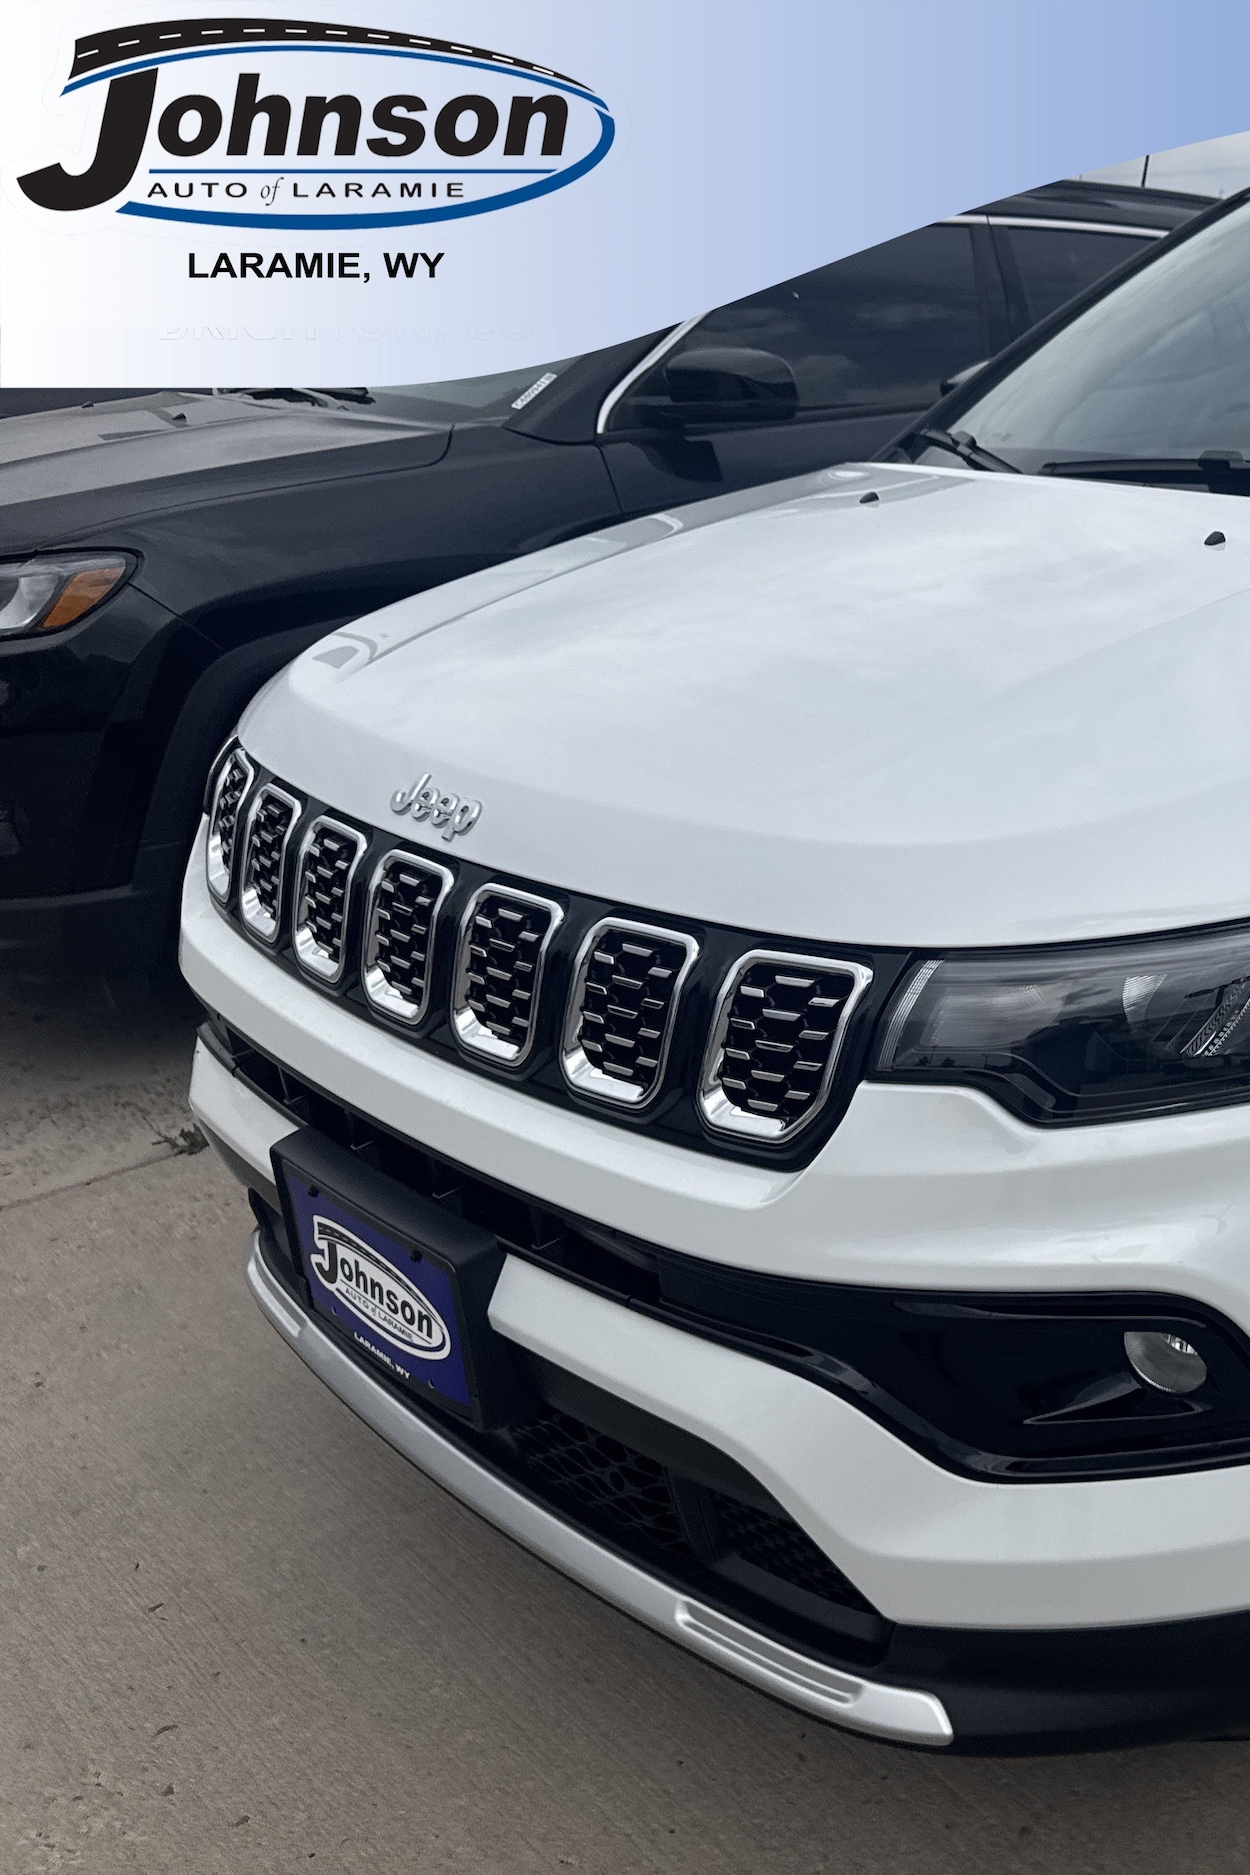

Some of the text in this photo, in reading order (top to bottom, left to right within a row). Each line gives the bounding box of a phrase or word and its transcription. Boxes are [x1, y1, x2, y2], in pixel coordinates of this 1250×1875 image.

[390, 771, 482, 842] Jeep
[315, 1241, 433, 1340] Johnson
[345, 1287, 370, 1311] AUTO
[379, 1312, 414, 1342] LARAMIE
[395, 1363, 411, 1379] WY
